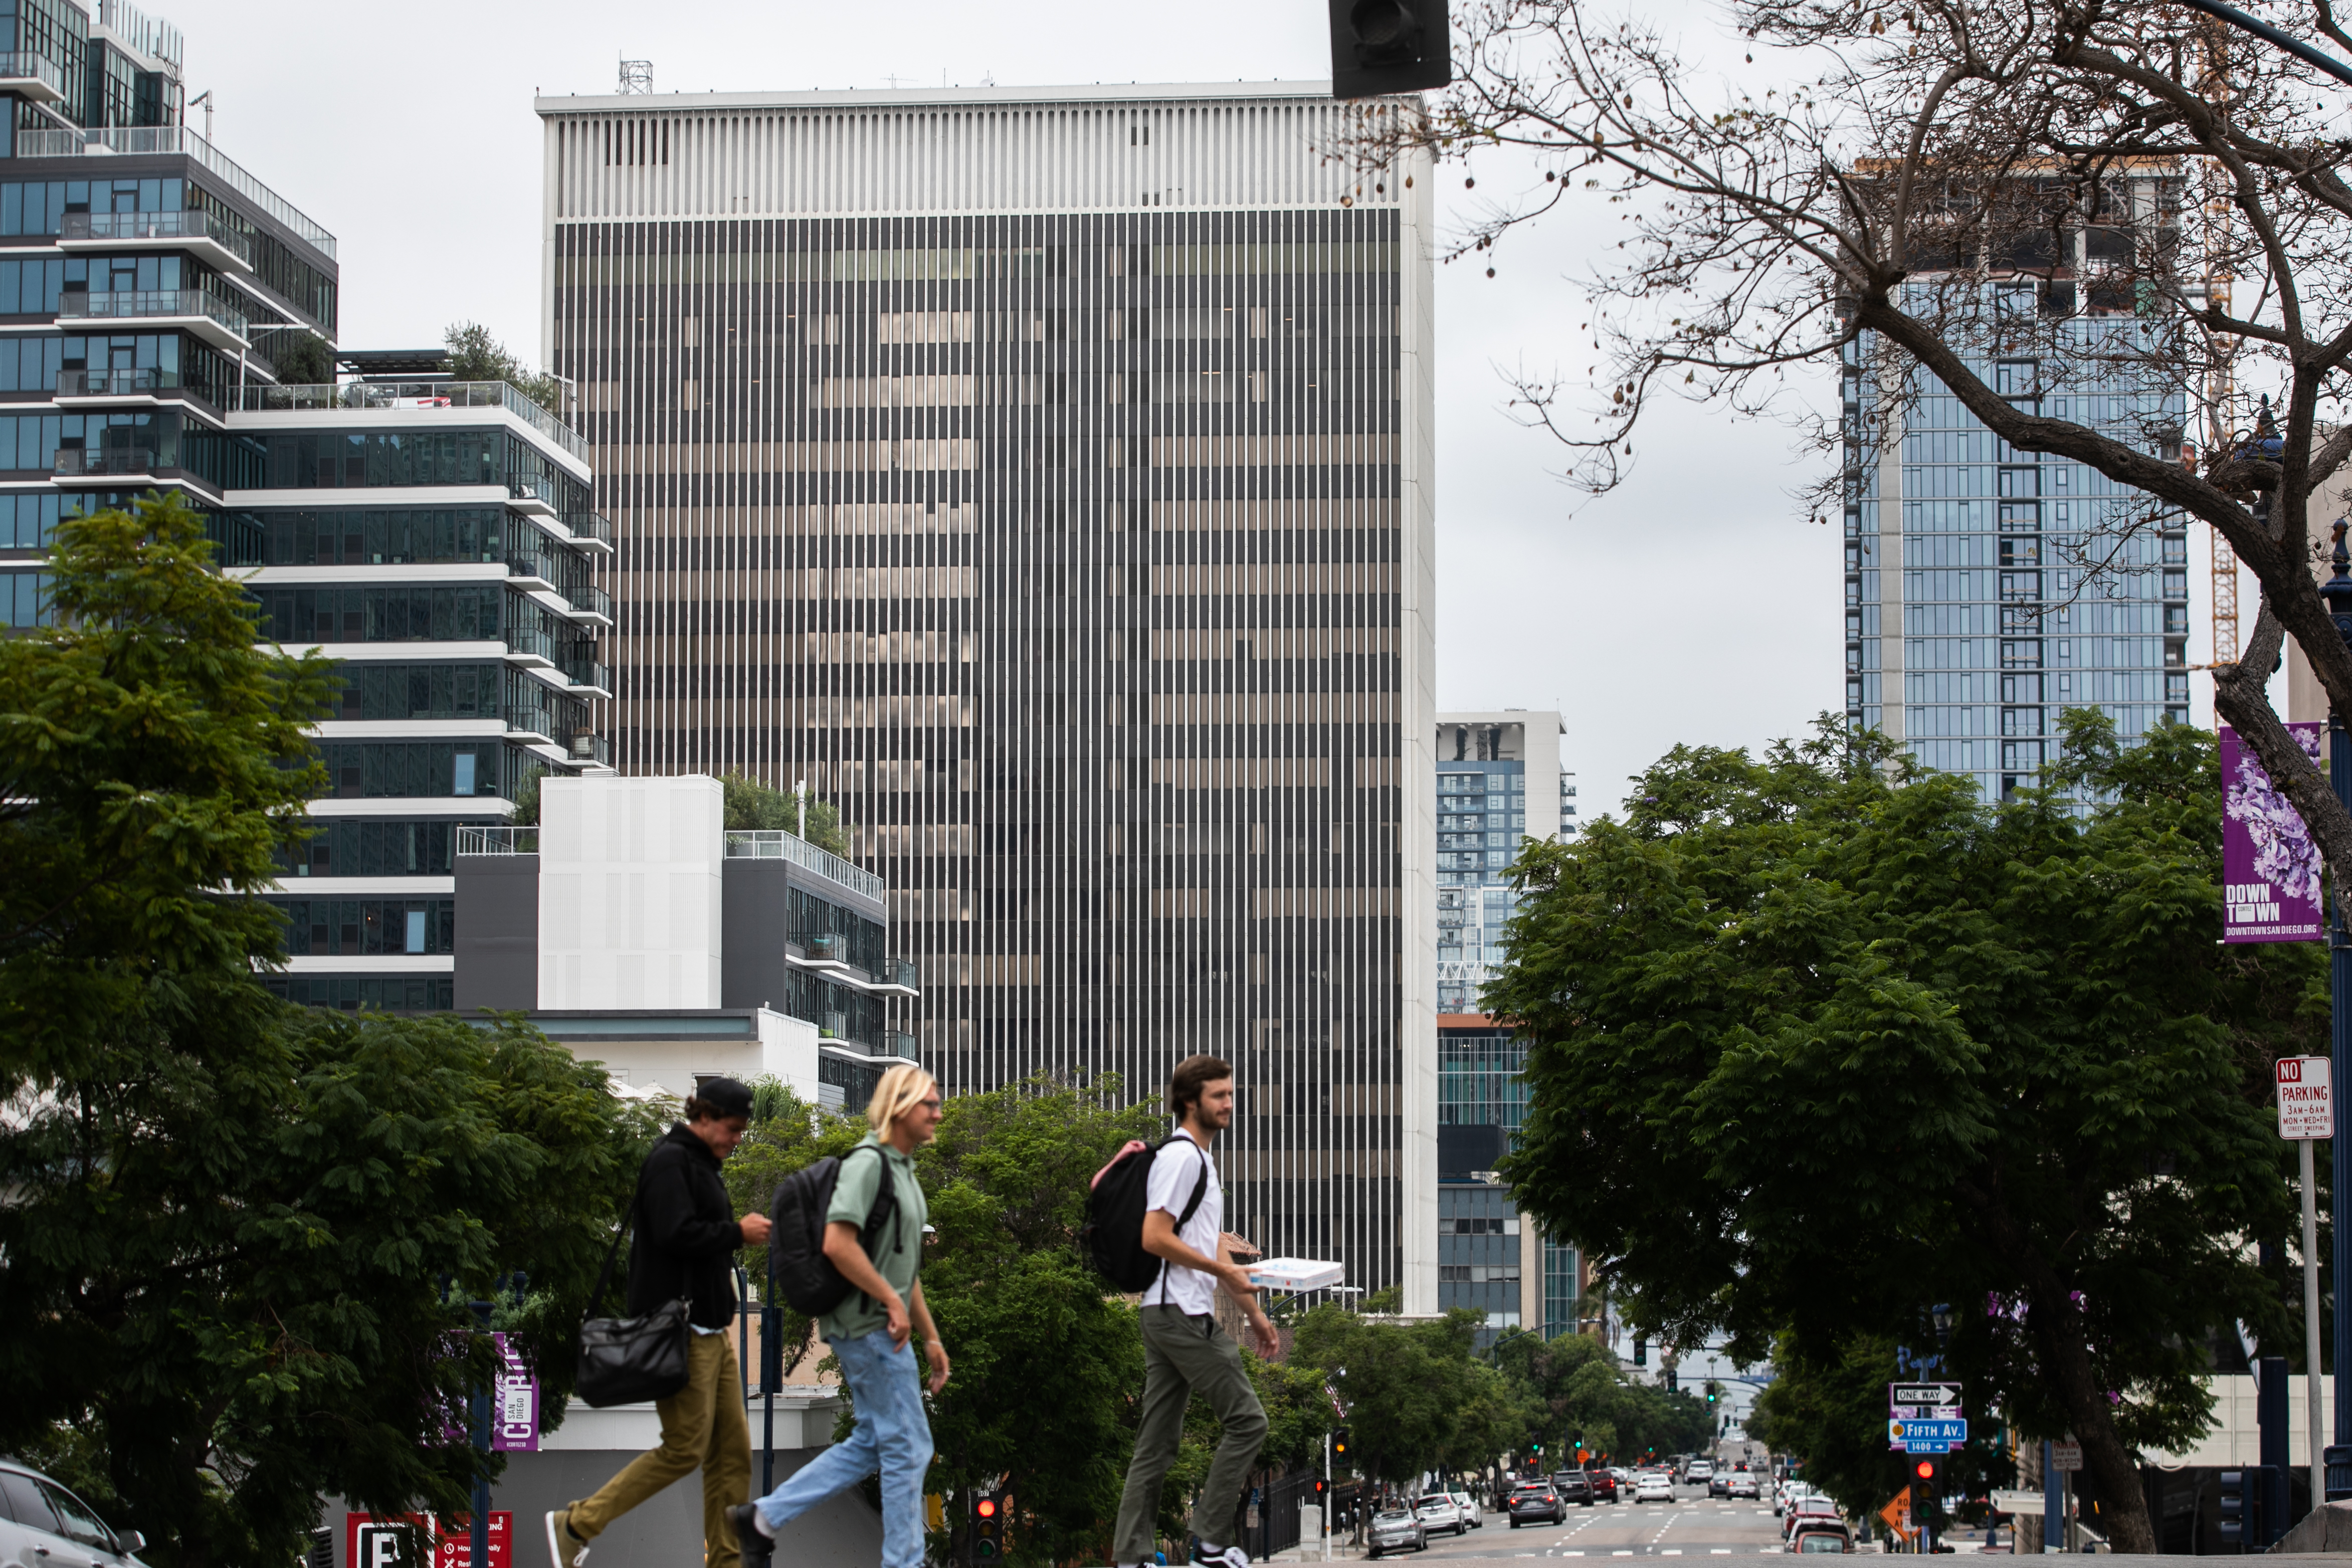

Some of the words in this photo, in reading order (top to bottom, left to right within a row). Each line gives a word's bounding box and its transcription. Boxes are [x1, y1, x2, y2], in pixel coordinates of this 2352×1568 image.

[2226, 883, 2270, 903] DOWN
[2281, 1062, 2298, 1079] NO
[2282, 1086, 2327, 1101] PARKING
[1900, 1391, 1918, 1399] ONE
[1922, 1391, 1940, 1399] WAY
[1912, 1442, 1931, 1451] 1400
[1898, 1498, 1908, 1506] RO
[488, 1544, 501, 1552] aily
